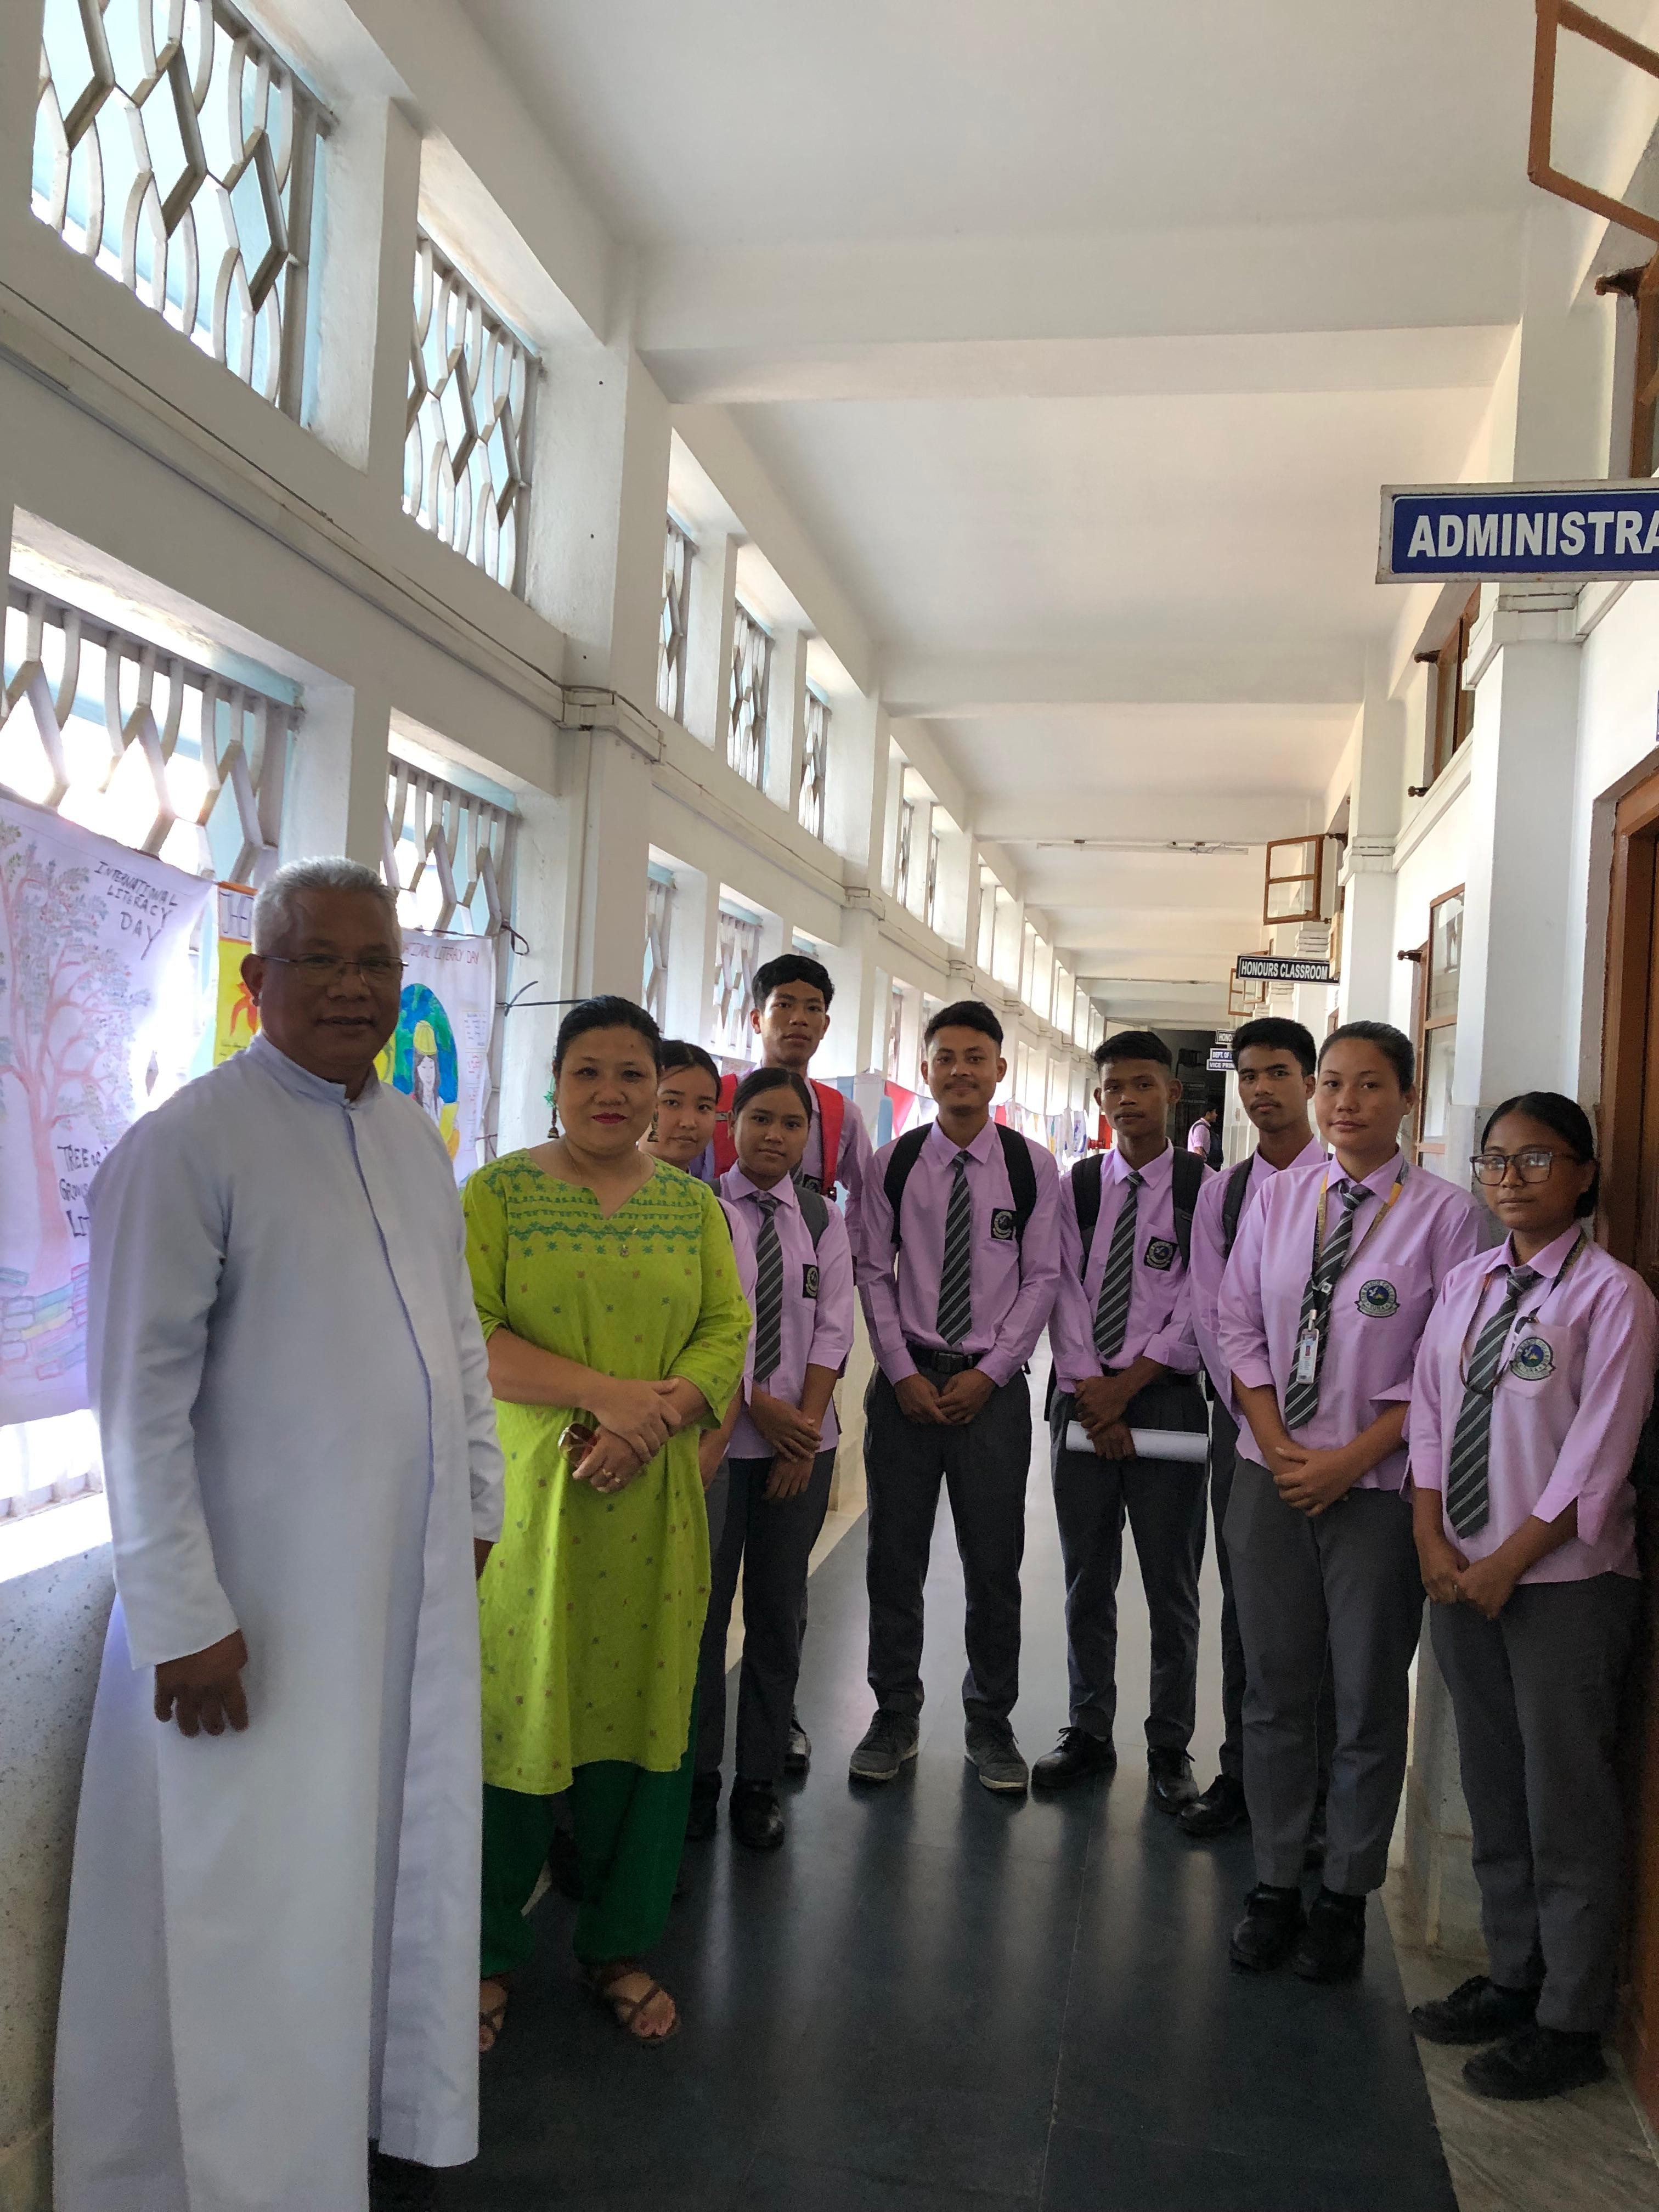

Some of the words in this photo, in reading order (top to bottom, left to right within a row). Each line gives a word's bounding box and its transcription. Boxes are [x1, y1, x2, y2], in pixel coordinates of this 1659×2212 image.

[1407, 511, 1659, 557] ADMINISTRA
[107, 885, 173, 928] LITERACY
[120, 911, 162, 961] DAY
[1242, 961, 1279, 977] HONOURS
[1280, 963, 1328, 980] CLASSROOM
[57, 1144, 89, 1172] TREE
